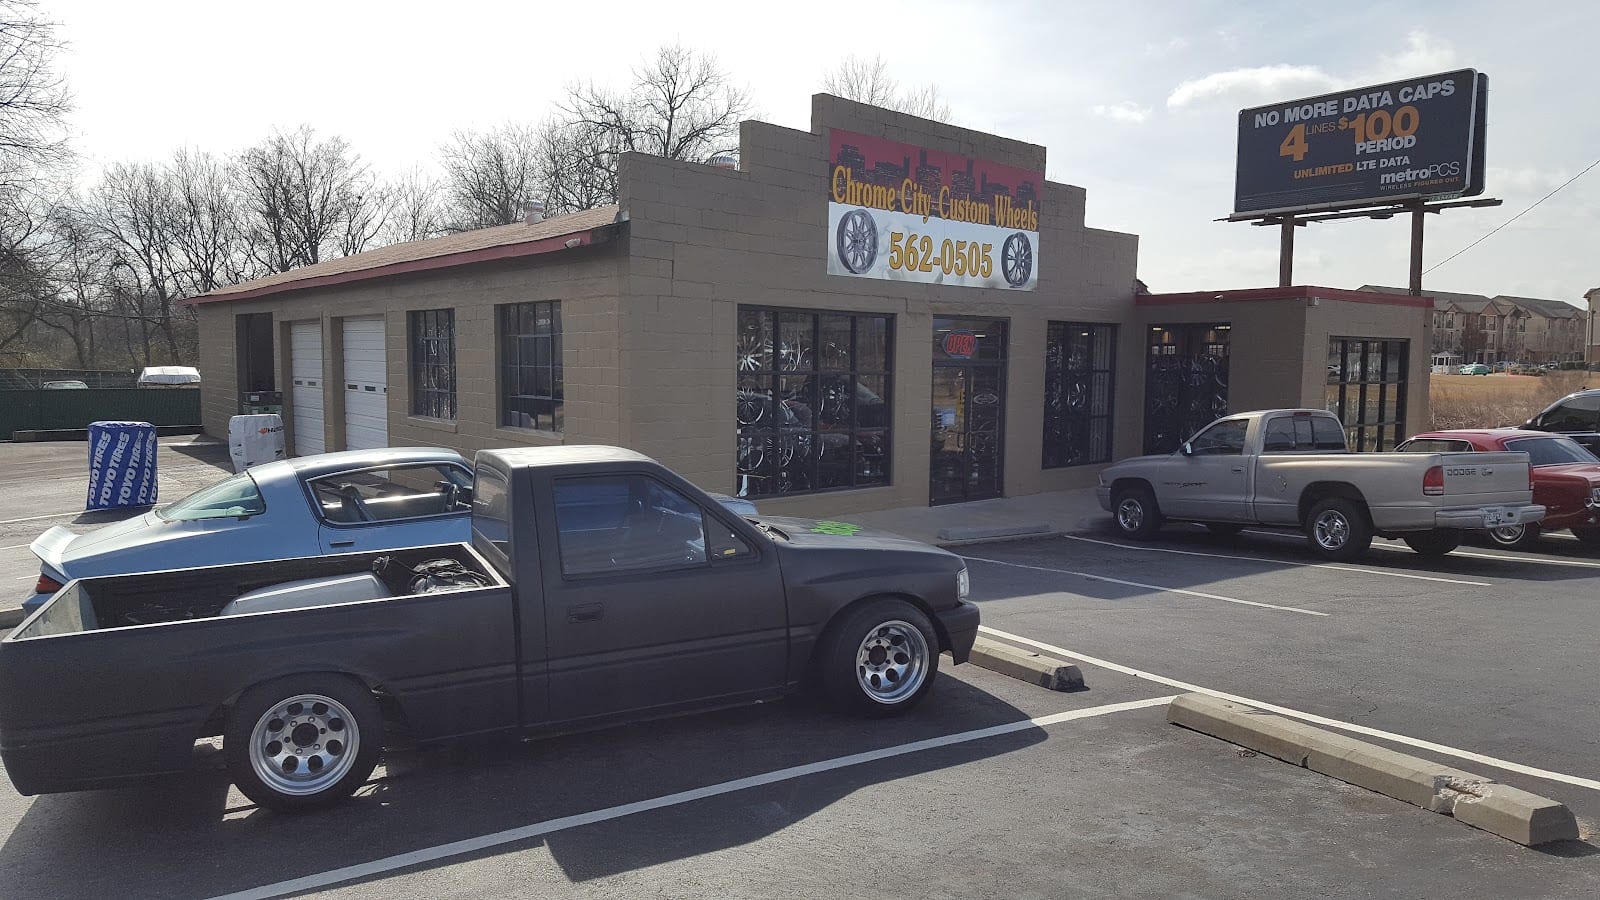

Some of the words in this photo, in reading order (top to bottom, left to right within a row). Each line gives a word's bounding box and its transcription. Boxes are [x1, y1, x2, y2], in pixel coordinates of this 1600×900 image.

[1255, 111, 1280, 129] NO
[1284, 100, 1338, 123] MORE
[1343, 91, 1393, 113] DATA
[1398, 80, 1455, 103] CAPS
[1280, 123, 1309, 161] 4
[1306, 121, 1336, 135] LINES
[1355, 135, 1417, 155] PERIOD
[1294, 163, 1353, 179] UNLIMITED
[1356, 160, 1377, 171] LTE
[1380, 156, 1410, 168] DATA
[832, 165, 897, 212] Chrome
[901, 178, 931, 223] City
[938, 185, 990, 225] Custom
[994, 194, 1038, 231] Wheels
[1380, 182, 1412, 191] WIRELESS
[888, 232, 993, 279] 562-0505
[946, 333, 976, 355] OPEN
[1447, 468, 1477, 476] DODGE
